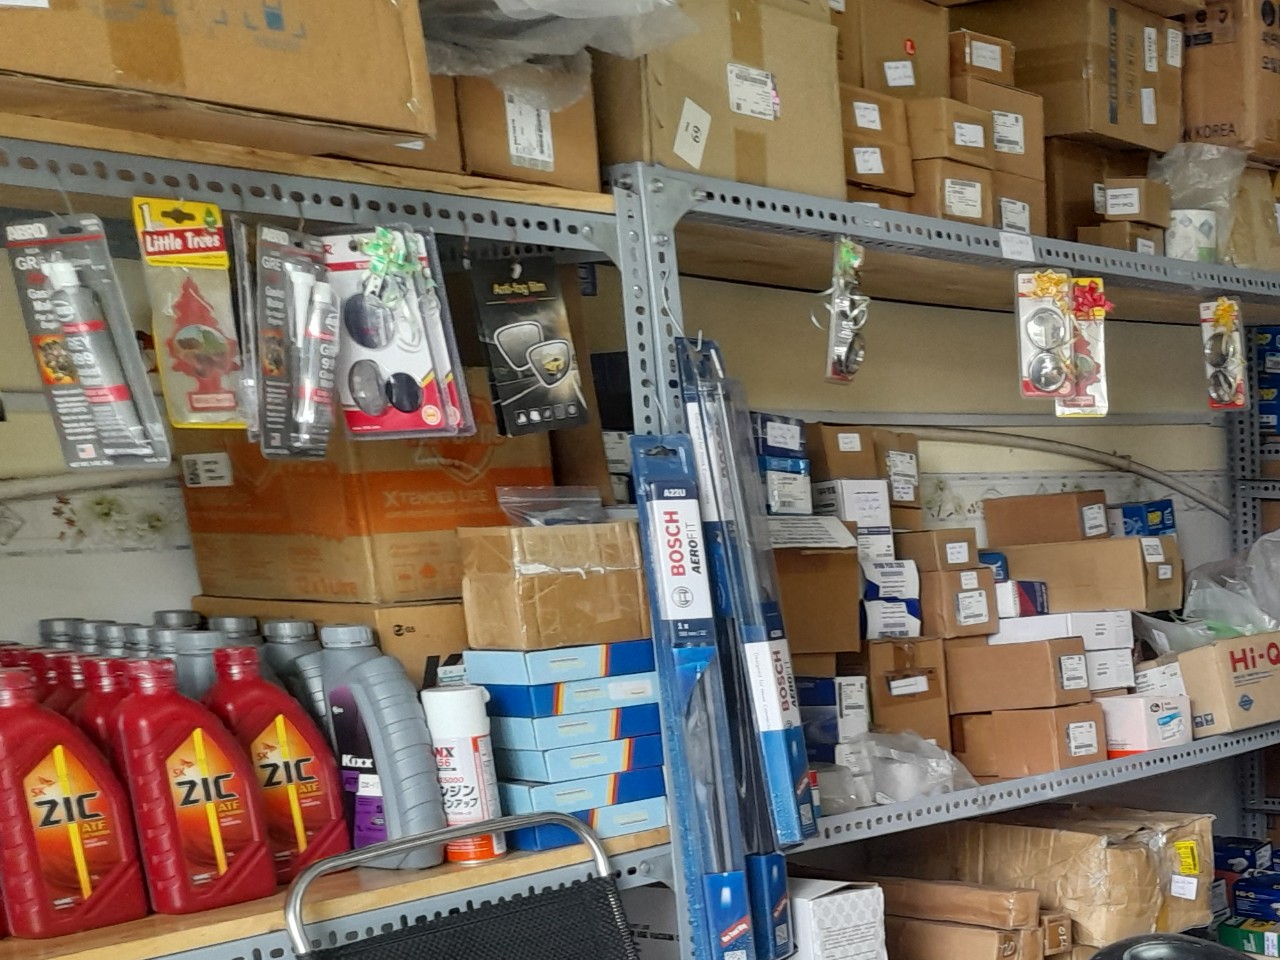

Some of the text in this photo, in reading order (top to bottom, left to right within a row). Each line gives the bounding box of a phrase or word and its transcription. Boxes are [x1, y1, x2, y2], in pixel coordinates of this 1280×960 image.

[1196, 123, 1236, 139] KOREA
[5, 223, 49, 241] ABRO
[145, 231, 221, 252] Little Trees
[663, 488, 687, 497] A22U
[663, 511, 686, 577] BOSCH
[685, 521, 702, 575] AEROFIT
[773, 650, 790, 712] BOSCH
[341, 754, 374, 768] Kixx
[173, 767, 186, 778] SK
[259, 756, 319, 788] ZIC
[32, 787, 46, 797] SK
[175, 772, 240, 807] ZIC
[299, 783, 320, 793] ATF
[33, 791, 104, 828] ZIC
[218, 801, 241, 812] ATF
[82, 821, 107, 833] ATF
